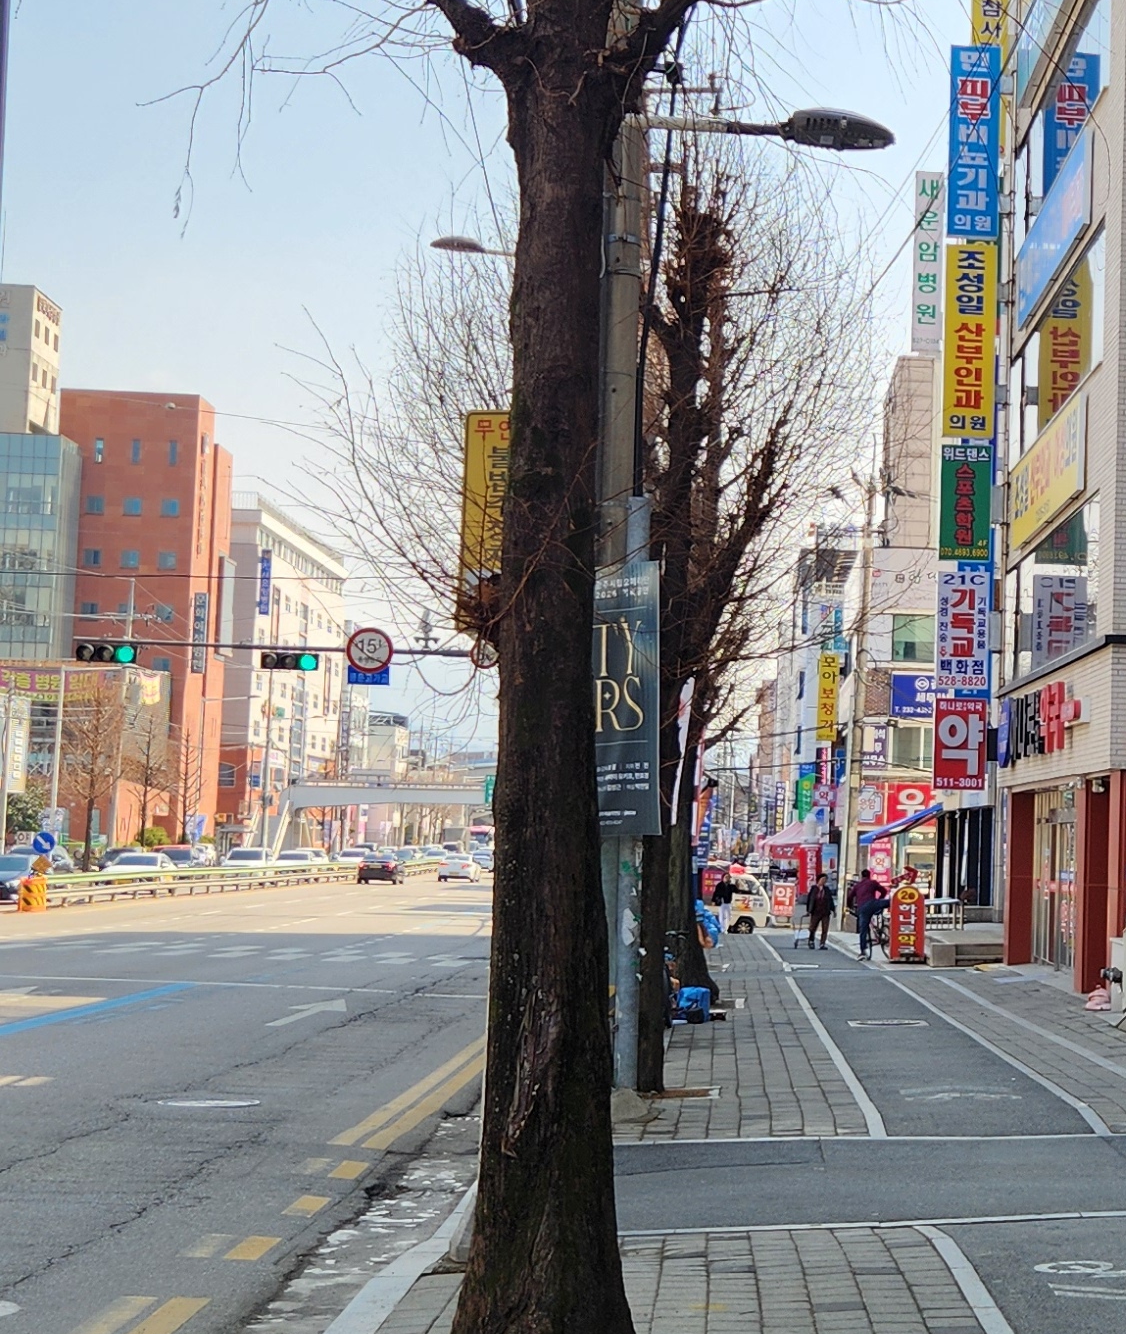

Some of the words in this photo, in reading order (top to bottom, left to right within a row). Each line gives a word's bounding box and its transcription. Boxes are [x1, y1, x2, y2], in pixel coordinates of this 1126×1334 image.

[953, 214, 992, 232] 의원
[916, 178, 941, 326] 새운암병원
[955, 250, 986, 316] 조성일
[953, 322, 986, 410] 산부인과
[949, 414, 986, 431] 의원
[943, 447, 990, 462] 위드댄스
[954, 463, 976, 546] 스포츠학원
[943, 573, 986, 586] 21C
[949, 587, 977, 658] 기독교
[939, 658, 985, 676] 백화점
[938, 675, 987, 687] 528-8820
[938, 713, 984, 776] 약
[936, 777, 983, 788] 511-3001
[775, 887, 794, 905] 약
